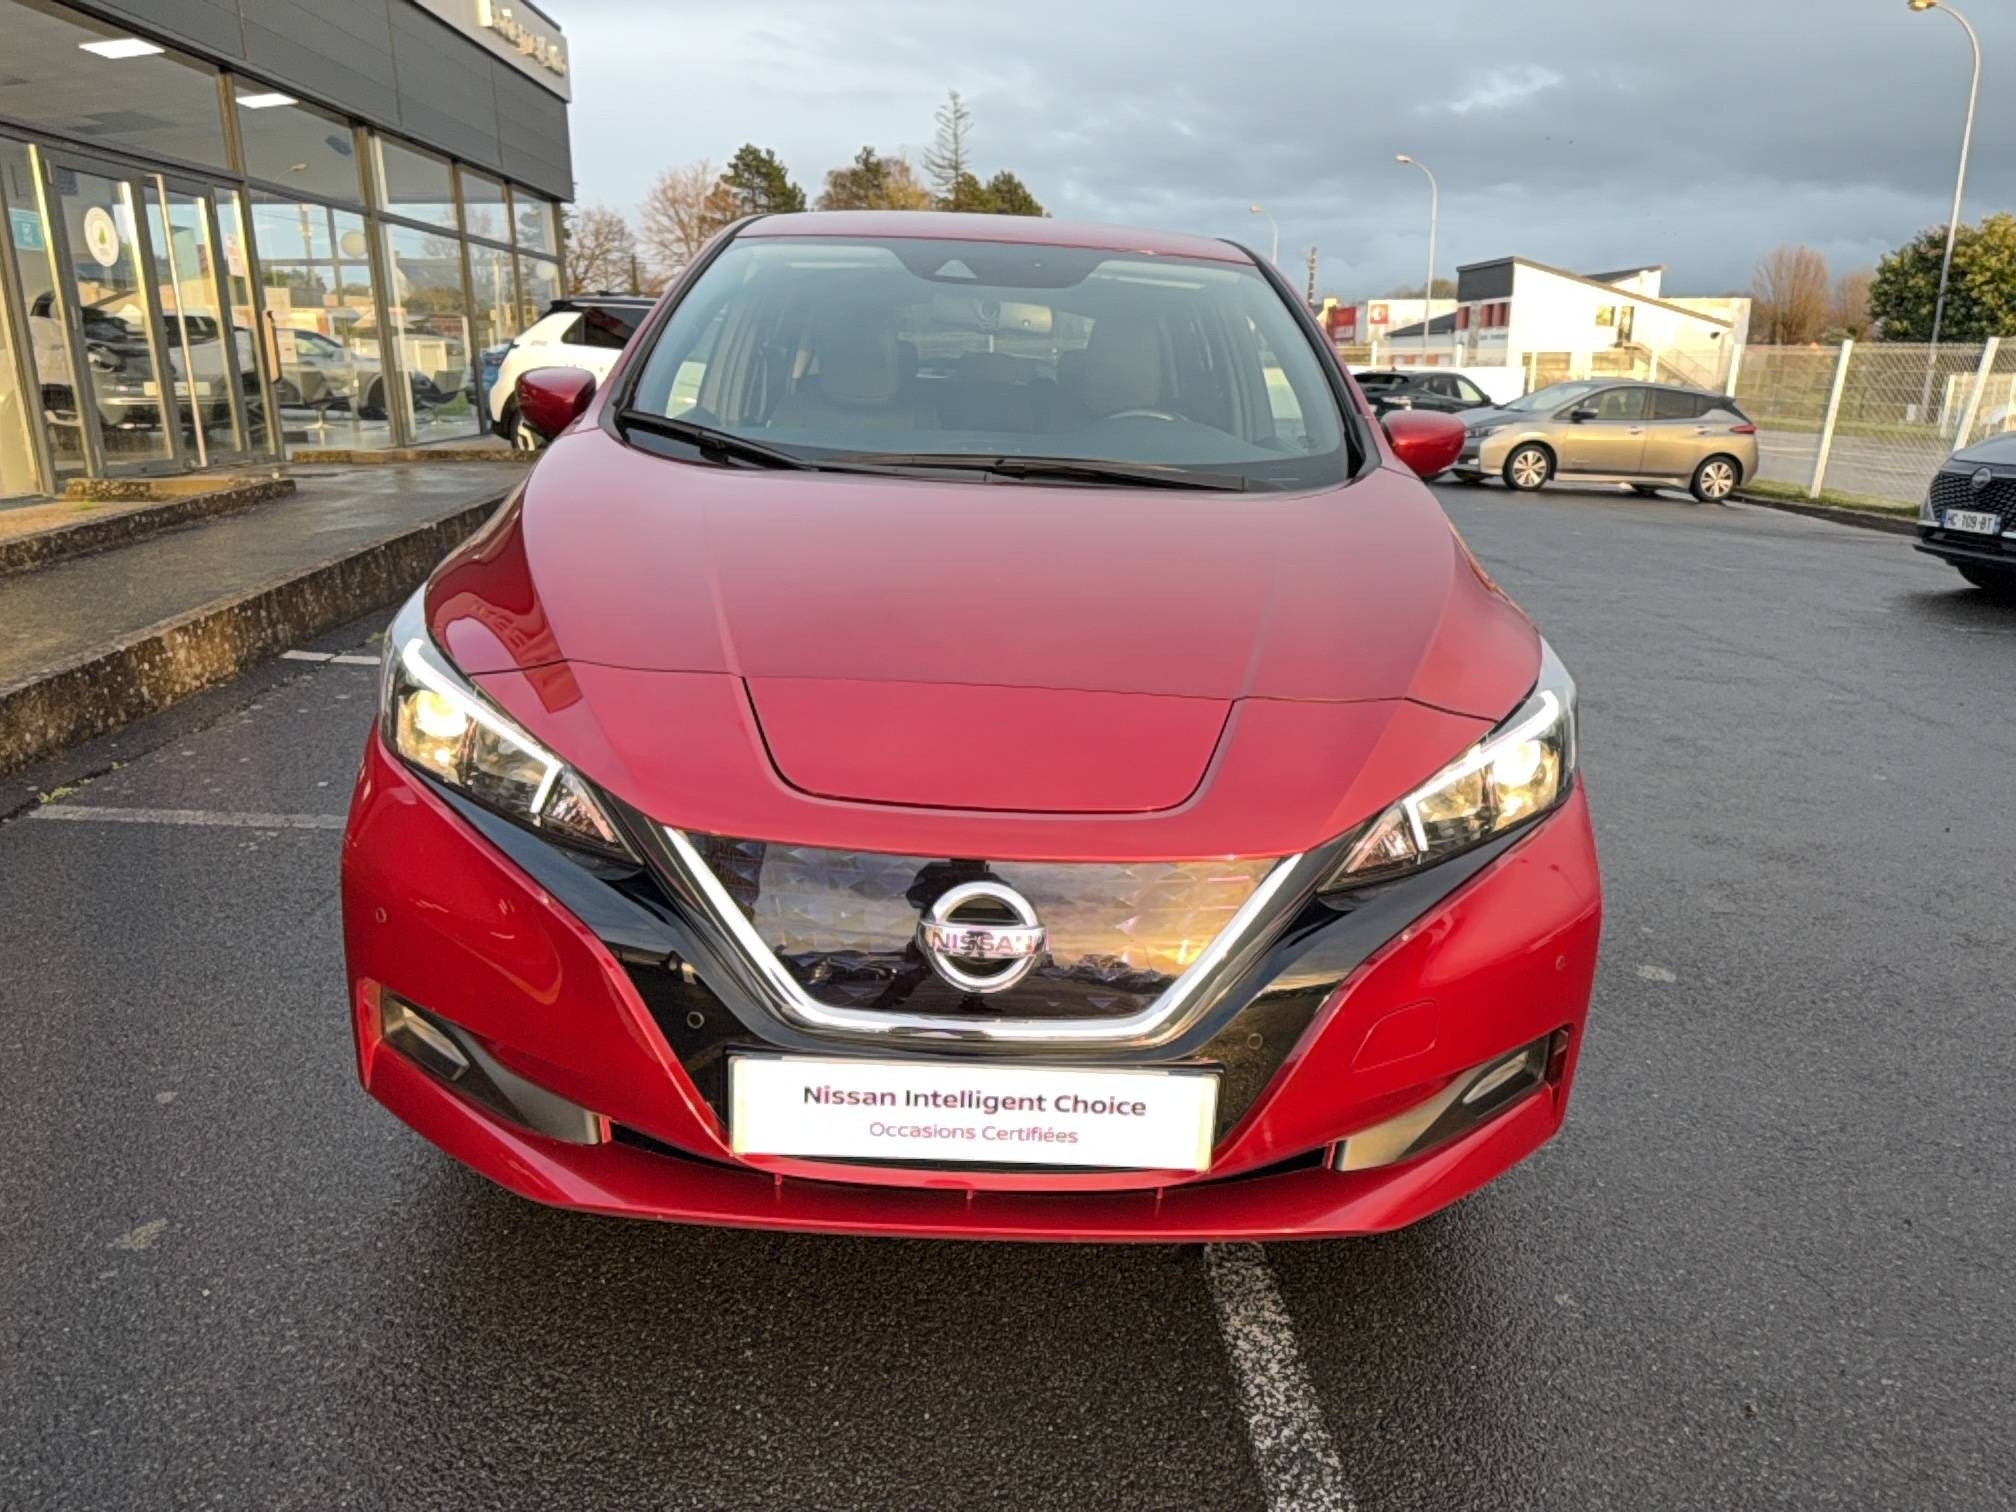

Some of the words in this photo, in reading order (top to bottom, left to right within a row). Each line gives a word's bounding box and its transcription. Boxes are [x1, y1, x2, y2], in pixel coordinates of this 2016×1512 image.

[931, 930, 1035, 953] NISSAN
[804, 1086, 897, 1107] Nissan
[905, 1089, 1047, 1115] Intelligent
[1054, 1094, 1147, 1116] Choice
[869, 1121, 976, 1140] Occasions
[982, 1124, 1079, 1143] Certifiées
